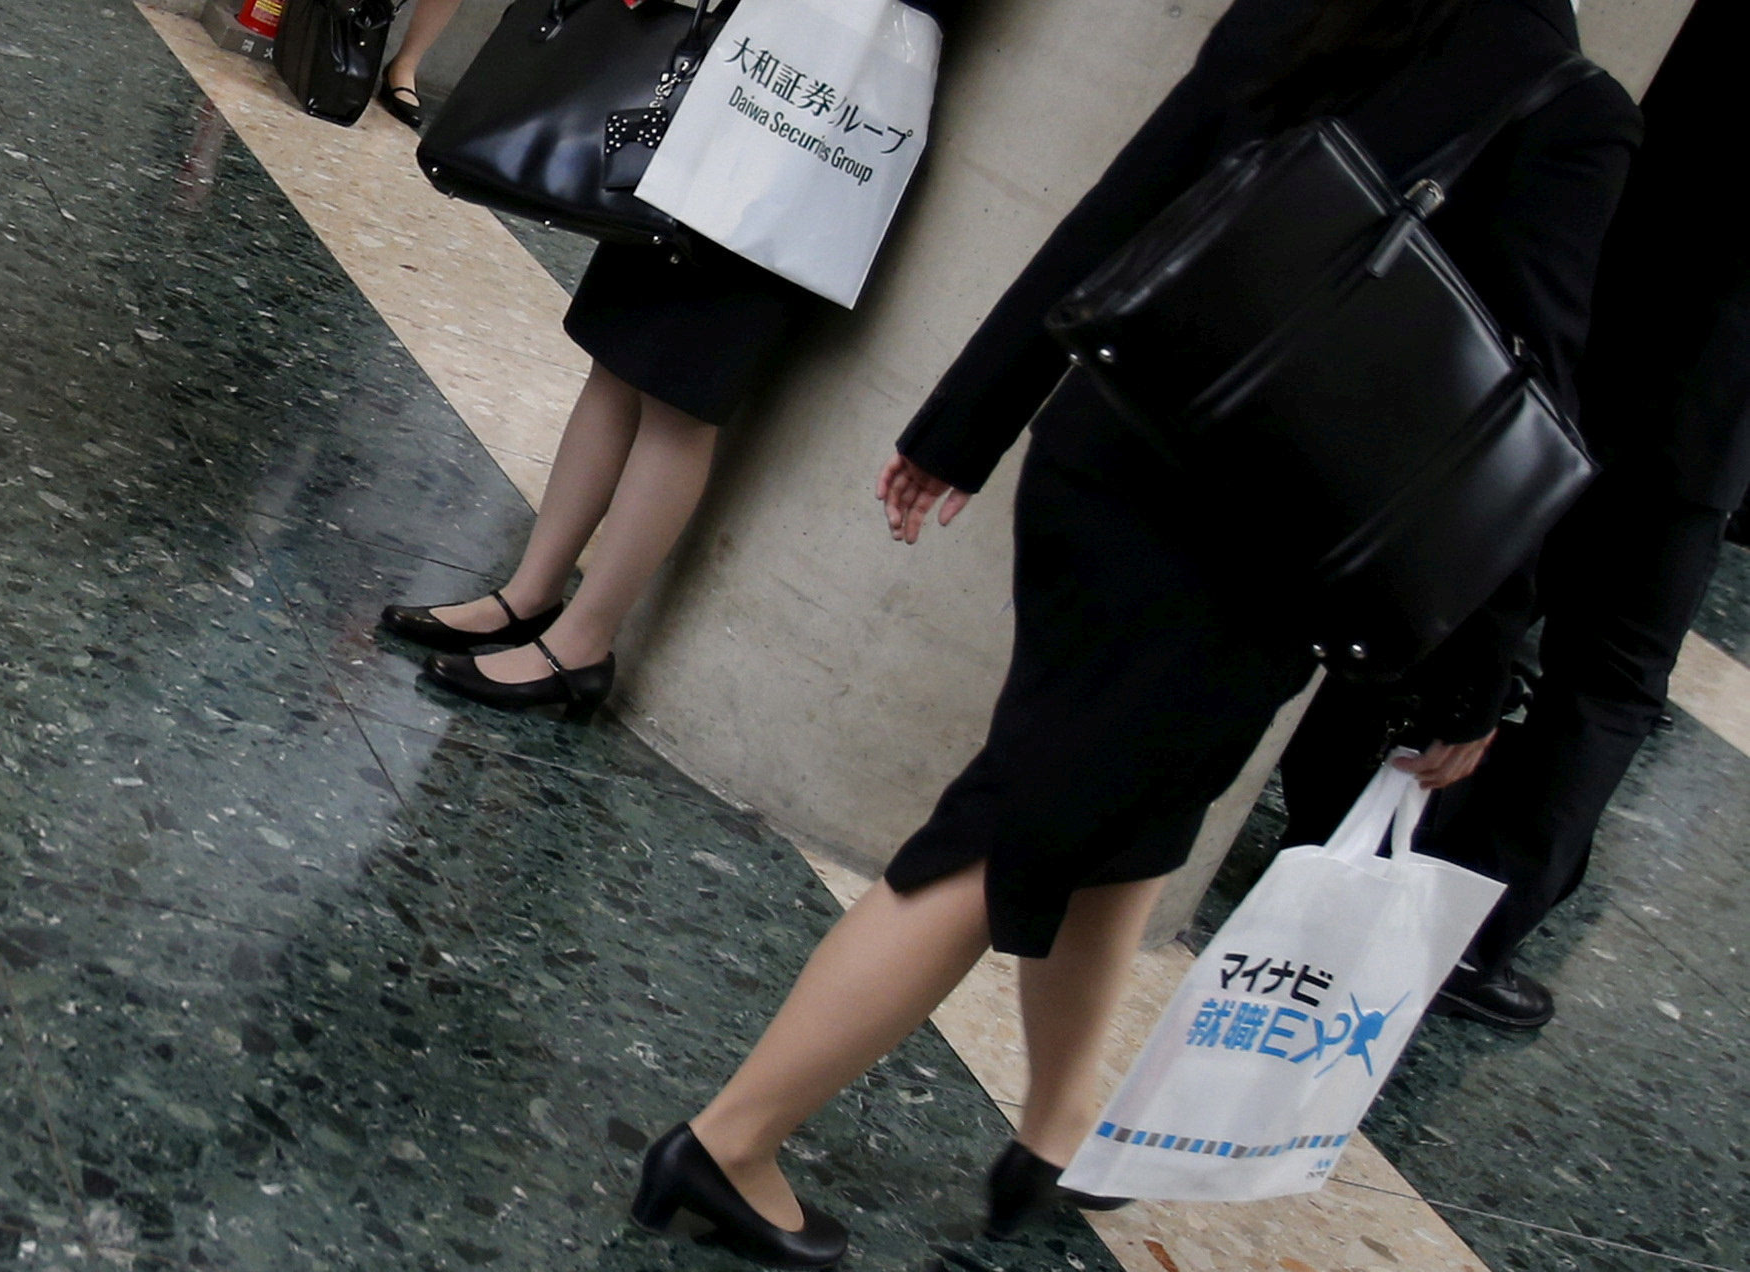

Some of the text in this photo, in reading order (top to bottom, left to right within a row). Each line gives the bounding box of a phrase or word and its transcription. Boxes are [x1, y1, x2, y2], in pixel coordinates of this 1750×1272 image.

[729, 85, 770, 127] Daiwa
[830, 146, 874, 187] Group
[1221, 953, 1334, 1007] マイナビ
